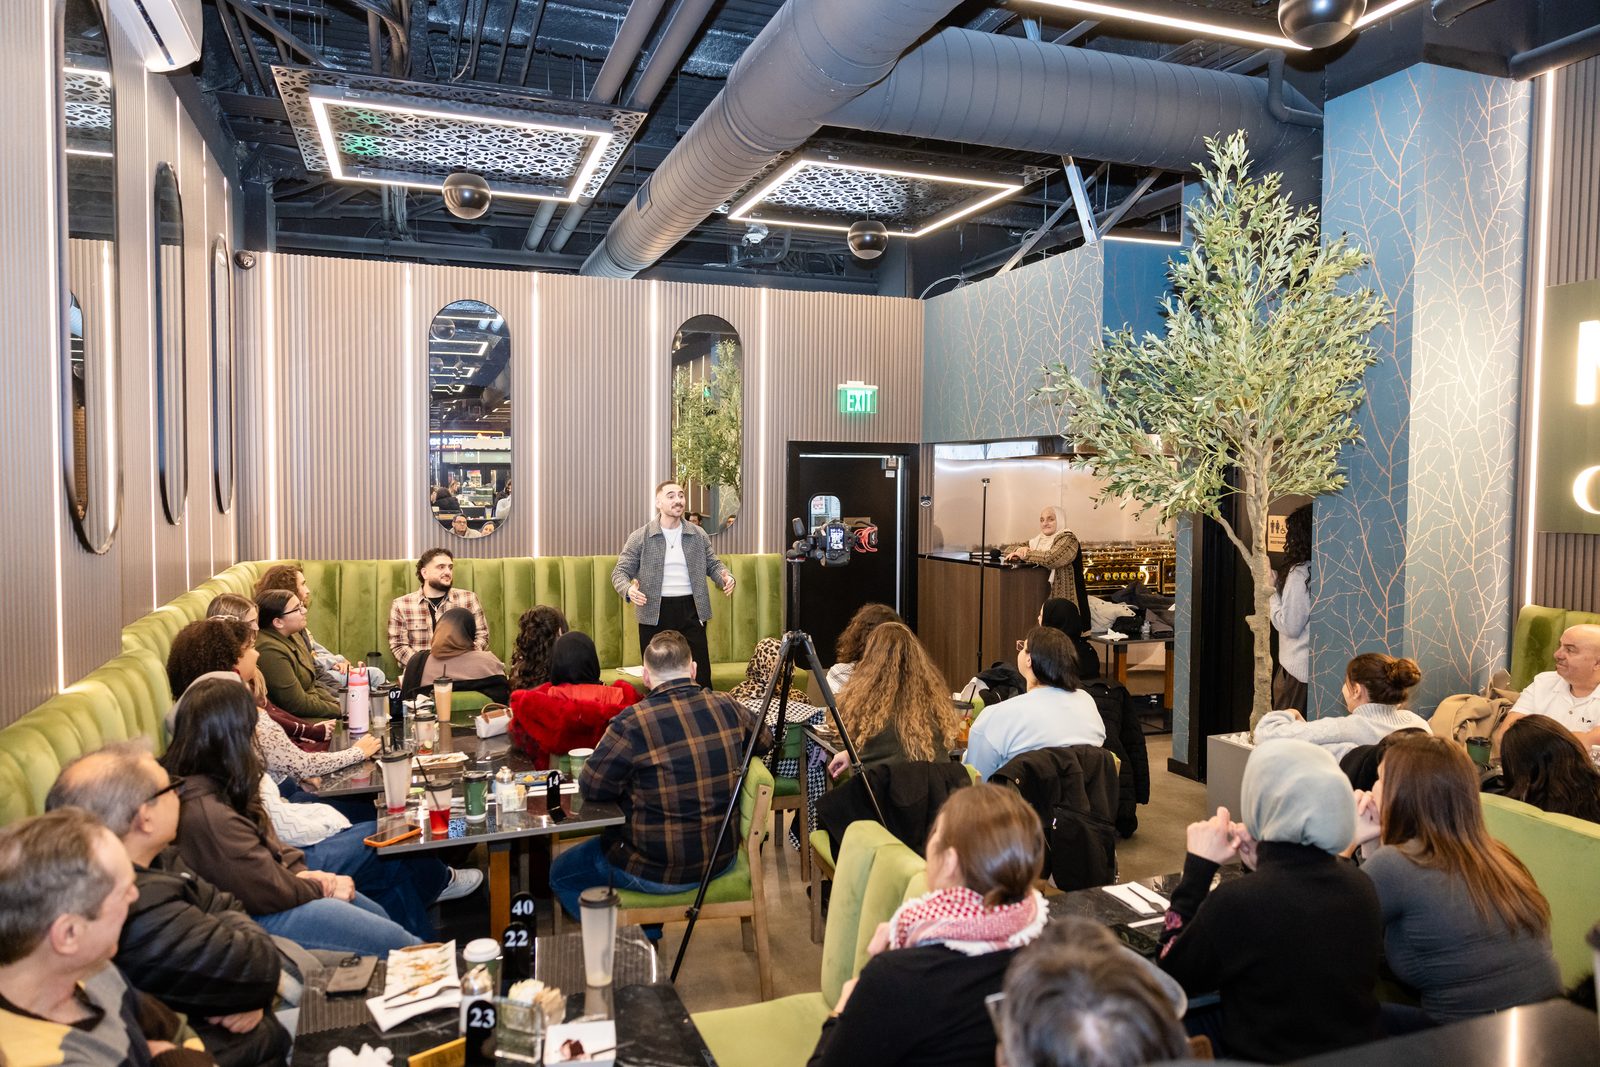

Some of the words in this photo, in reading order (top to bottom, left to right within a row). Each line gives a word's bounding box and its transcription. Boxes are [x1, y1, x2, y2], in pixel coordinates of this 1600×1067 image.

[847, 390, 872, 412] EXIT
[389, 690, 401, 699] 07
[548, 775, 559, 788] 14
[511, 899, 535, 916] 40
[504, 930, 529, 948] 22
[469, 1007, 496, 1029] 23
